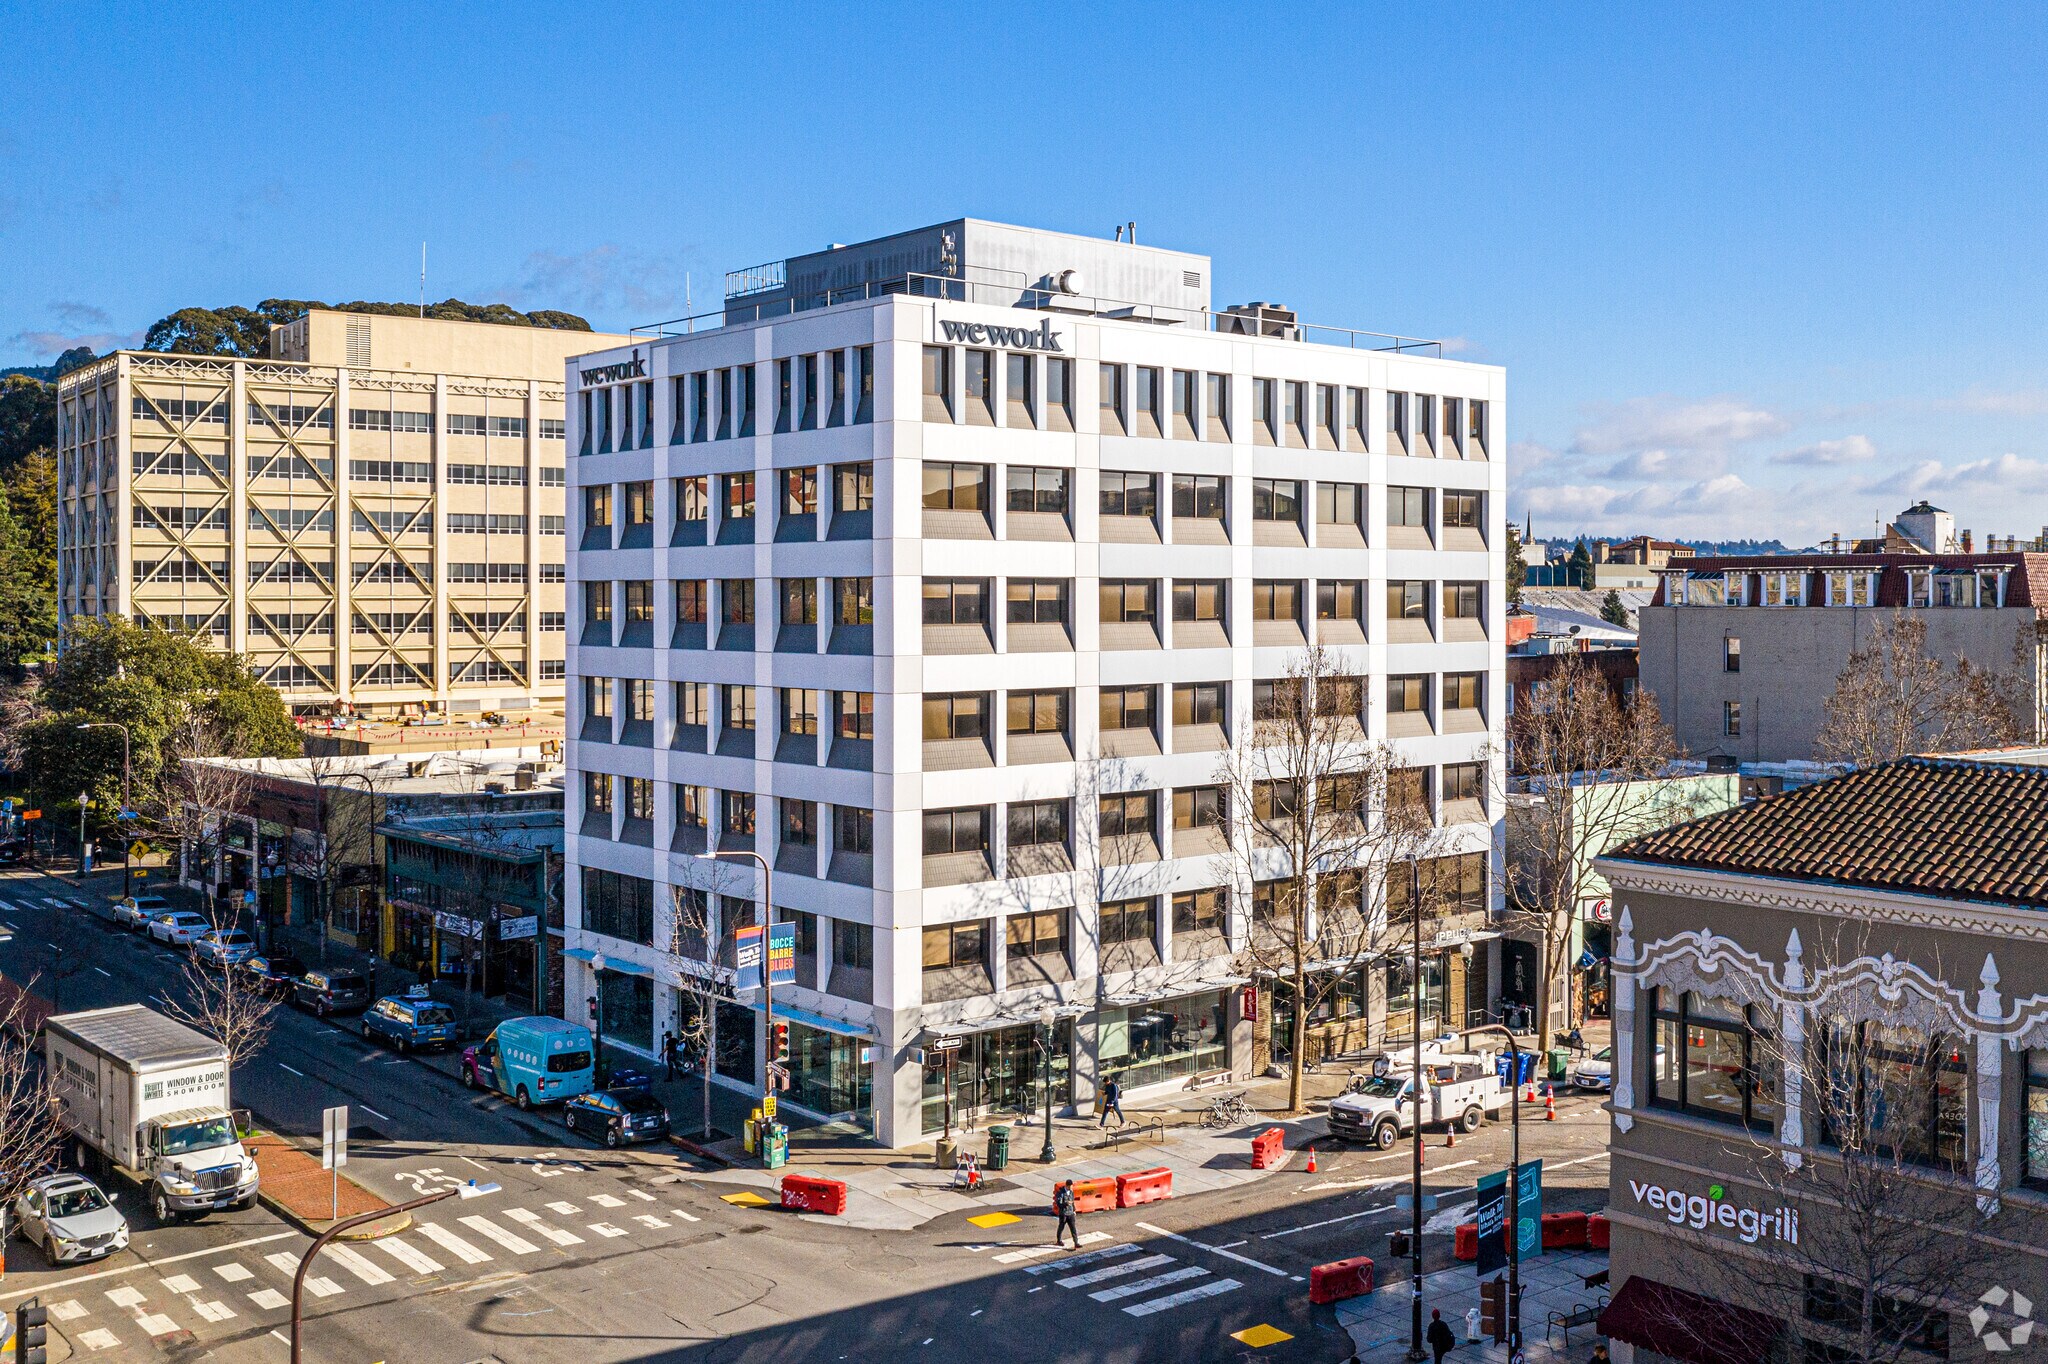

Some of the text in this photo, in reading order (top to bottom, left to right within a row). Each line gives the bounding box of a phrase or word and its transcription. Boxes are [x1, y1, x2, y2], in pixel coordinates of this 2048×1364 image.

[939, 317, 1063, 352] wework
[580, 348, 646, 386] wework
[770, 937, 794, 949] BOCCE
[770, 948, 794, 960] BARRE
[770, 958, 794, 971] BLUES
[167, 1070, 225, 1088] WINDOW & DOOR
[167, 1081, 225, 1097] SHOWROOM
[1629, 1180, 1798, 1245] veggiegrill
